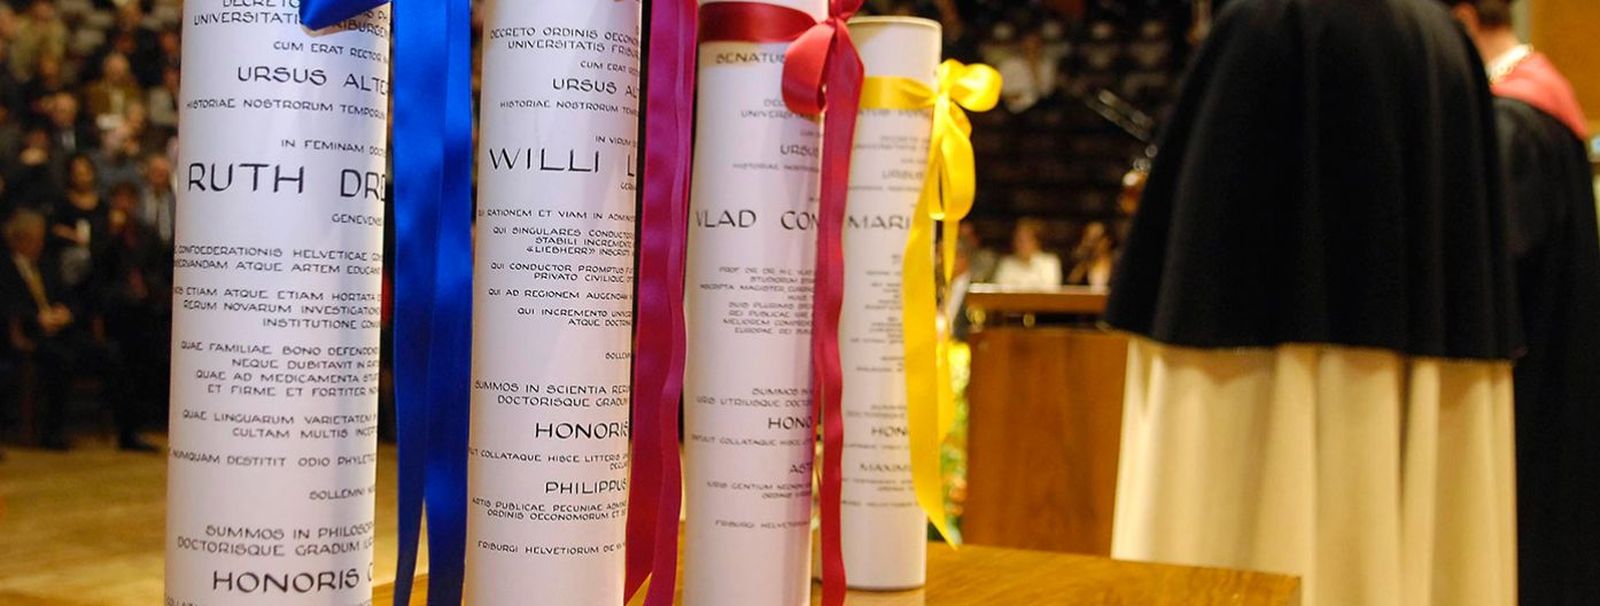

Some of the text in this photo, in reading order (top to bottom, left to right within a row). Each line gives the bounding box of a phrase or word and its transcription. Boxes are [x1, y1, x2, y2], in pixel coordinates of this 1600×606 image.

[194, 11, 304, 26] UNIVERSITATI
[542, 27, 598, 39] ORDINIS
[273, 41, 304, 51] CUM
[311, 43, 344, 55] ERAT
[508, 40, 605, 52] UNIVERSITATIS
[580, 60, 603, 70] CUM
[607, 63, 626, 72] ERAT
[237, 66, 327, 86] URSUS
[552, 78, 617, 95] URSUS
[243, 99, 333, 112] NOSTRORUM
[500, 100, 618, 113] HISTORIAE NOSTRORUM
[281, 139, 295, 148] IN
[304, 140, 365, 153] FEMINAM
[489, 148, 599, 173] WILLI
[188, 162, 305, 194] RUTH
[488, 209, 532, 217] RATIONEM
[593, 212, 602, 220] IN
[697, 210, 756, 228] VLAD
[493, 226, 506, 235] QUI
[512, 227, 581, 237] SINGULARES
[535, 236, 577, 245] STABILI
[293, 249, 368, 261] HELVETICAE
[236, 261, 283, 272] ATQUE
[291, 264, 341, 275] ARTEM
[491, 262, 504, 270] QUI
[509, 263, 572, 272] CONDUCTOR
[534, 272, 578, 281] PRIVATO
[186, 286, 218, 297] ETIAM
[224, 289, 268, 299] ATQUE
[277, 291, 324, 301] ETIAM
[488, 288, 501, 296] QUI
[505, 289, 519, 297] AD
[525, 290, 580, 299] REGIONEM
[184, 300, 292, 314] RERUM NOVARUM
[517, 307, 535, 315] QUI
[541, 308, 607, 318] INCREMENTO
[263, 318, 356, 330] INSTITUTIONE
[568, 318, 601, 327] ATQUE
[181, 341, 203, 351] QUAE
[209, 343, 272, 355] FAMILIAE
[282, 346, 321, 355] BONO
[232, 359, 279, 369] NEQUE
[287, 360, 352, 370] DUBITAVIT
[196, 370, 358, 383] QUAE AD MEDICAMENTA
[207, 384, 365, 397] ET FIRME ET FORTITER
[474, 380, 519, 392] SUMMOS
[525, 384, 540, 393] IN
[547, 385, 607, 395] SCIENTIA
[497, 394, 590, 407] DOCTORISQUE
[183, 410, 207, 420] QUAE
[214, 413, 295, 425] LINGUARUM
[232, 428, 349, 439] CULTAM MULTIS
[227, 455, 287, 467] DESTITIT
[298, 457, 330, 467] ODIO
[481, 450, 541, 461] COLLATAQUE
[547, 455, 580, 463] HISCE
[495, 501, 545, 512] PUBLICAE
[553, 503, 602, 512] PECUNIAE
[487, 509, 524, 519] ORDINIS
[530, 512, 609, 521] OECONOMORUM
[612, 511, 620, 519] ET
[206, 525, 284, 540] SUMMOS
[293, 529, 310, 539] IN
[177, 536, 285, 557] DOCTORISQUE
[295, 541, 360, 556] GRADUM
[525, 546, 599, 554] HELVETIORUM
[213, 568, 359, 593] HONORIS
